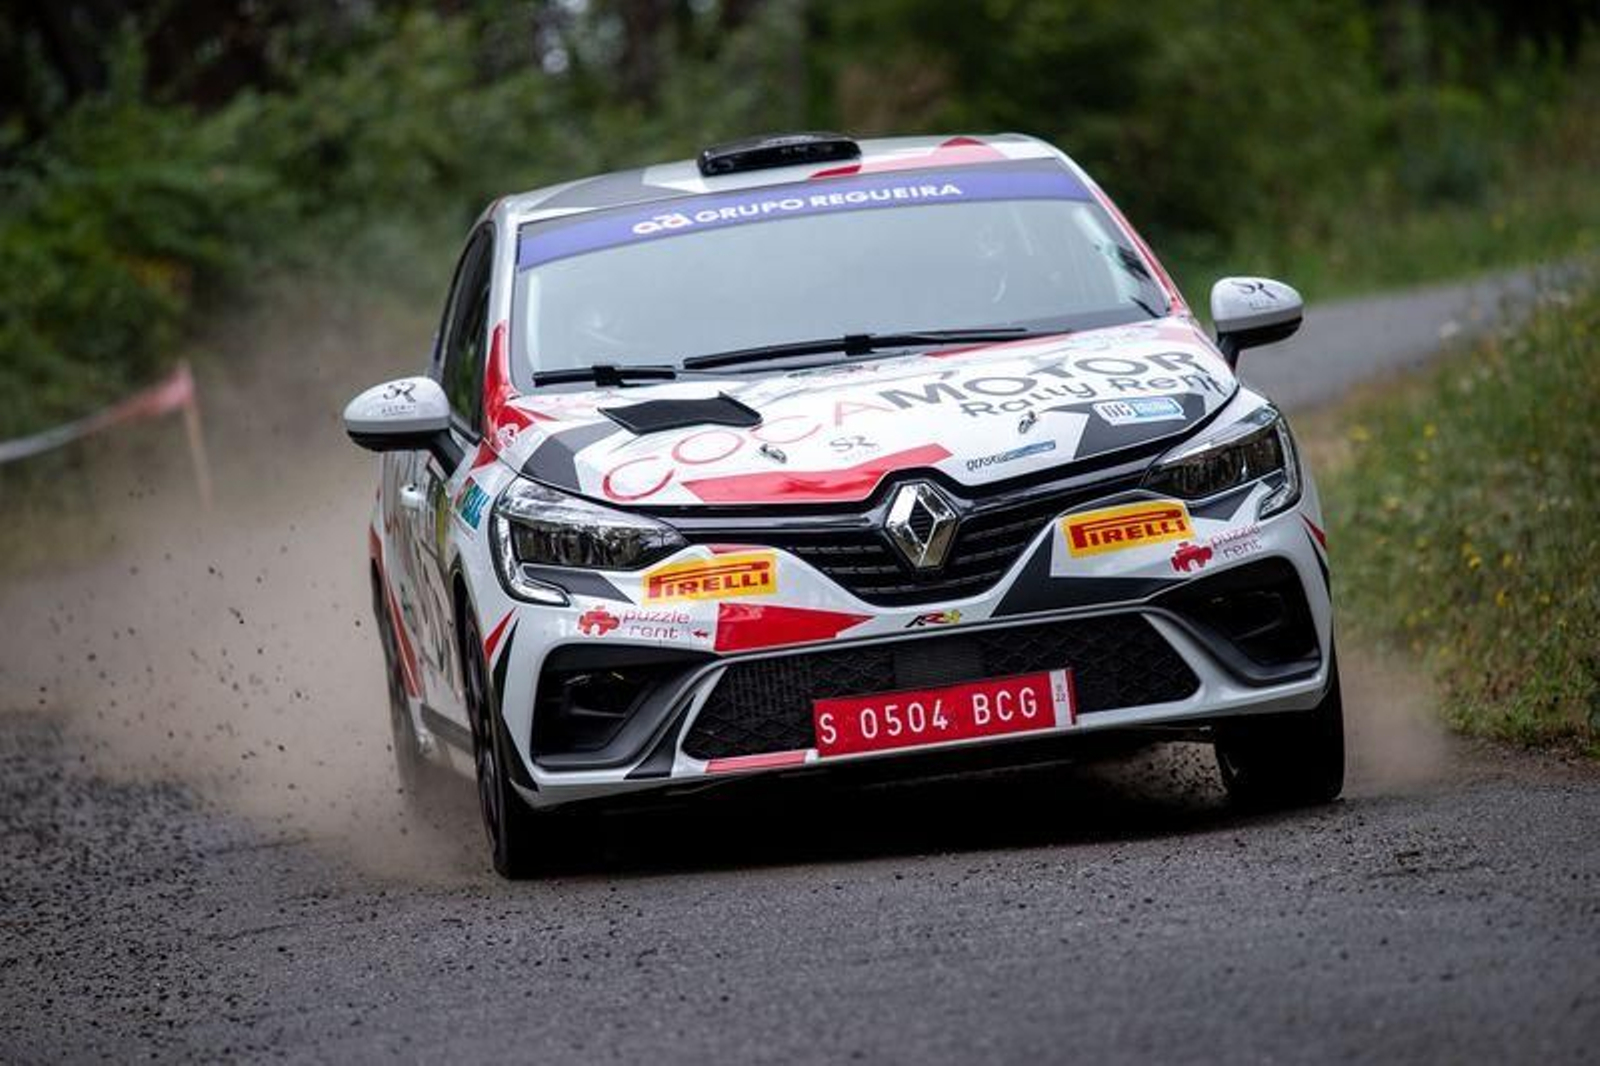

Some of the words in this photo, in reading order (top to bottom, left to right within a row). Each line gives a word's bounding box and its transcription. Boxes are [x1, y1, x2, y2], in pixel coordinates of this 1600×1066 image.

[695, 198, 805, 223] GRUPO
[809, 184, 963, 208] REGUEIRA
[959, 381, 1098, 418] Rally
[1106, 373, 1228, 397] Rent
[1069, 508, 1187, 550] PIRELLI
[647, 560, 771, 599] PIRELLI
[622, 608, 691, 625] puzzle
[629, 624, 679, 640] rent
[818, 713, 837, 744] S
[859, 699, 949, 740] 0504
[971, 686, 1038, 726] BCG
